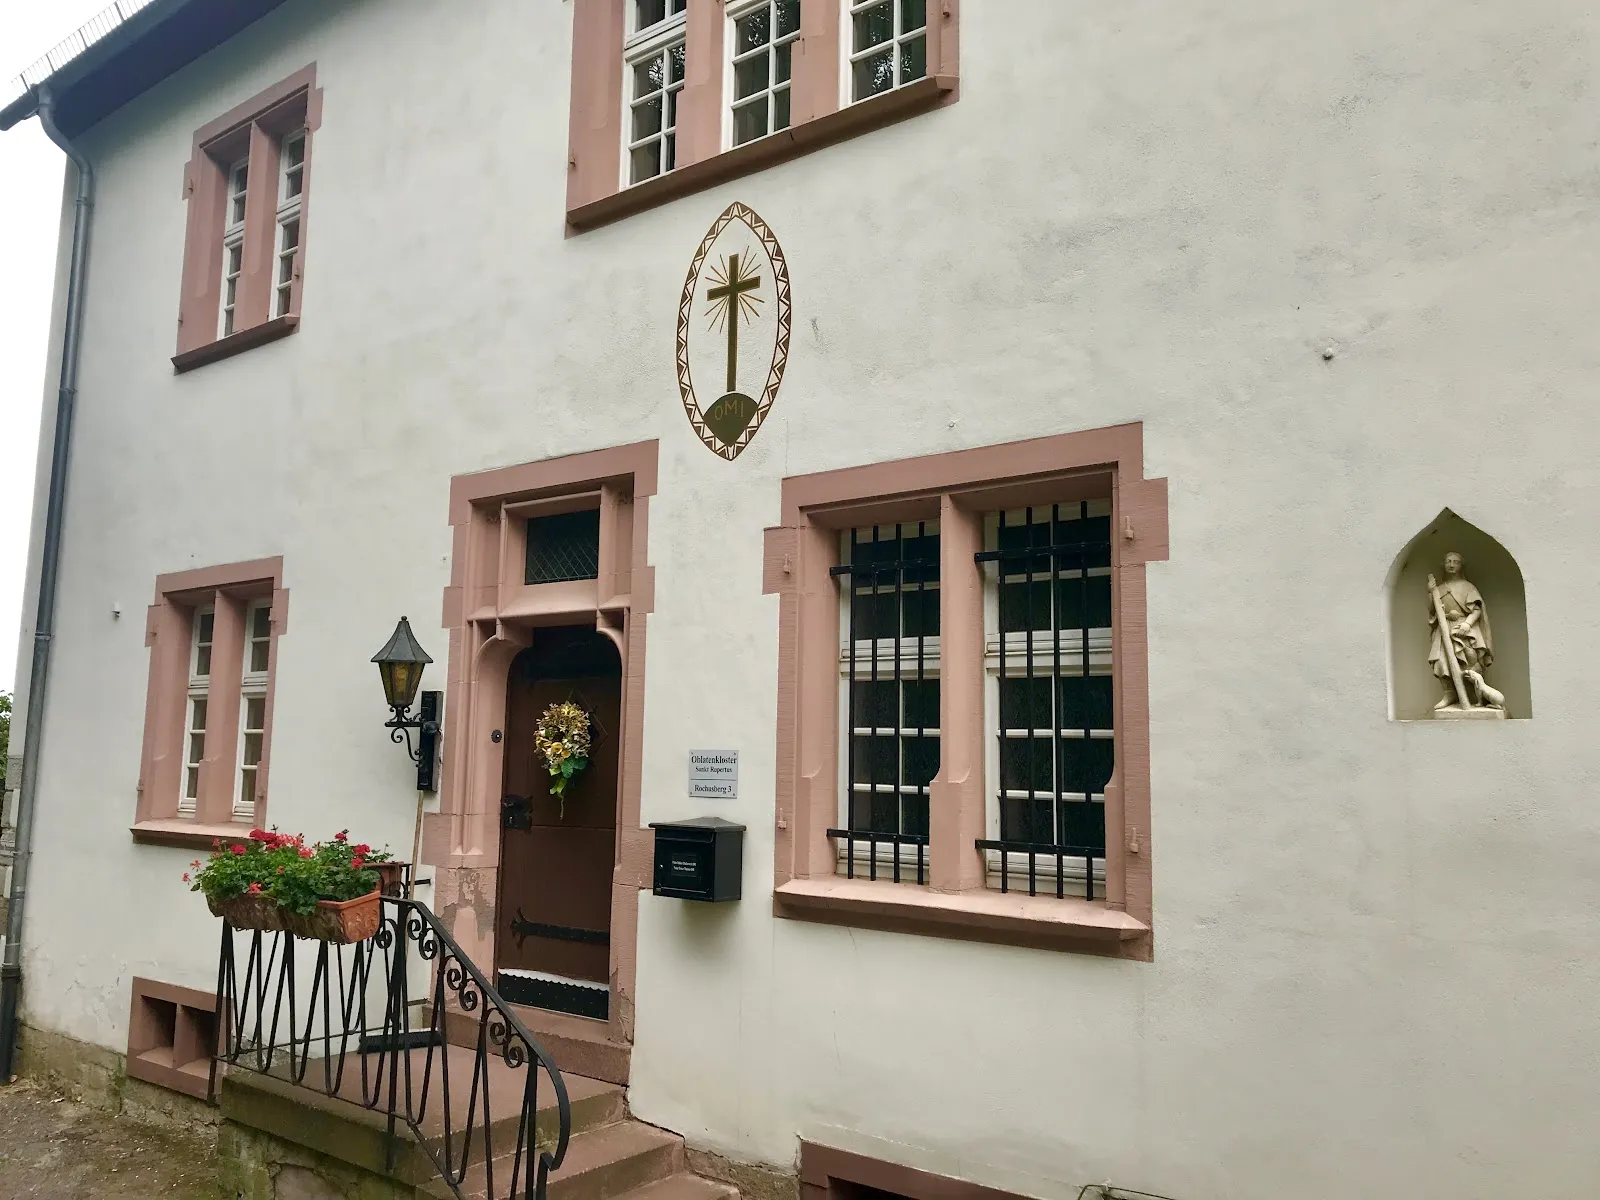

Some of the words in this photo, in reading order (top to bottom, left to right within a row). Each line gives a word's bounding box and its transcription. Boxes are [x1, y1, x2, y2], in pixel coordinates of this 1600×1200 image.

[714, 399, 744, 420] OMI
[691, 755, 737, 764] Oblatenkloster
[710, 766, 732, 774] Rupertus
[694, 784, 727, 794] Rochusberg
[727, 785, 732, 793] 3
